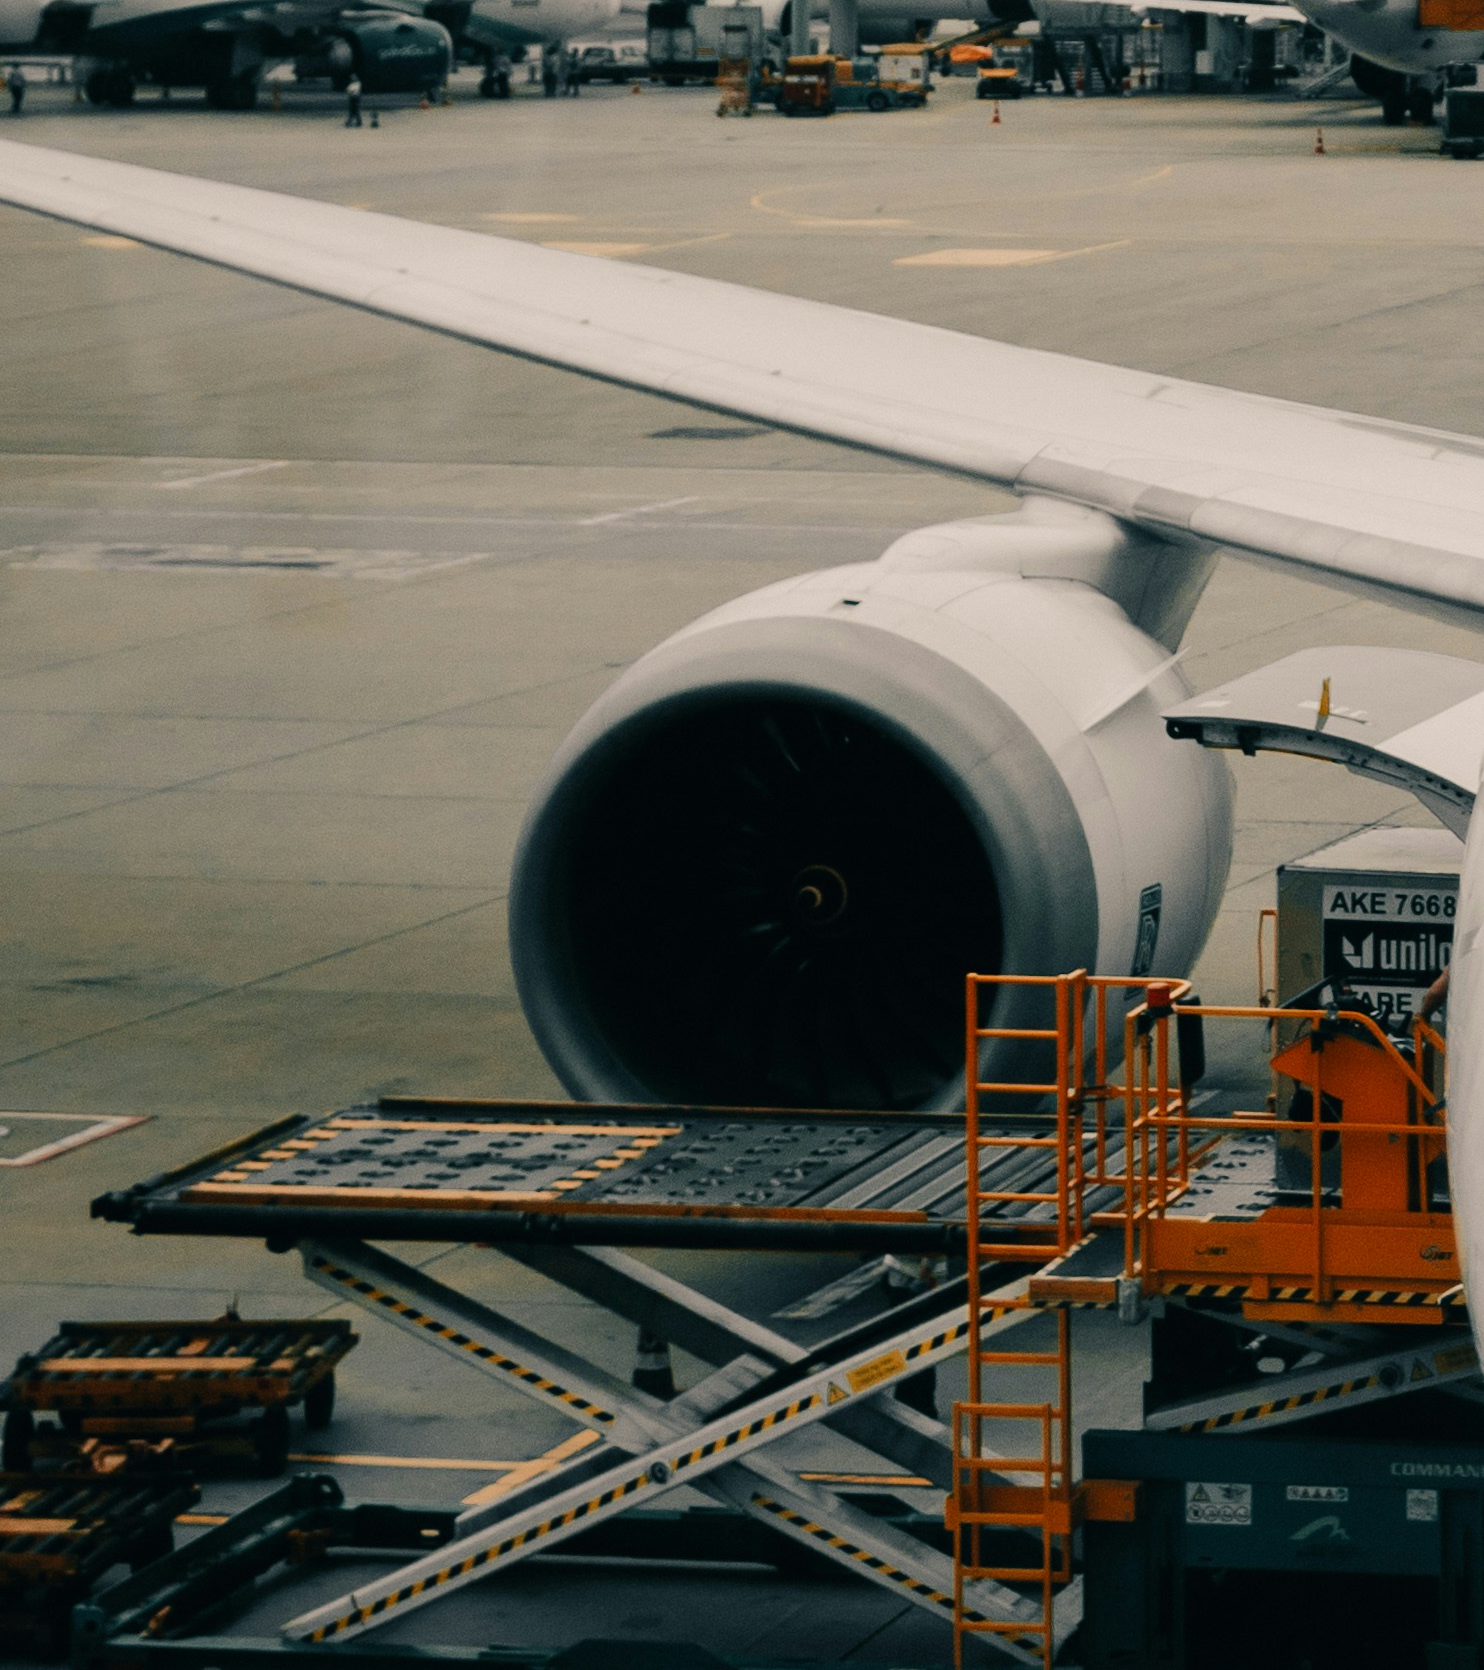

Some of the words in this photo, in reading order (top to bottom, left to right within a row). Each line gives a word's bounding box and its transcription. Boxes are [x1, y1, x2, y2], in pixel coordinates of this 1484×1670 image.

[1330, 892, 1386, 914] AKE
[1395, 895, 1456, 917] 7668
[1380, 933, 1453, 972] unilo
[1353, 992, 1412, 1014] ARE
